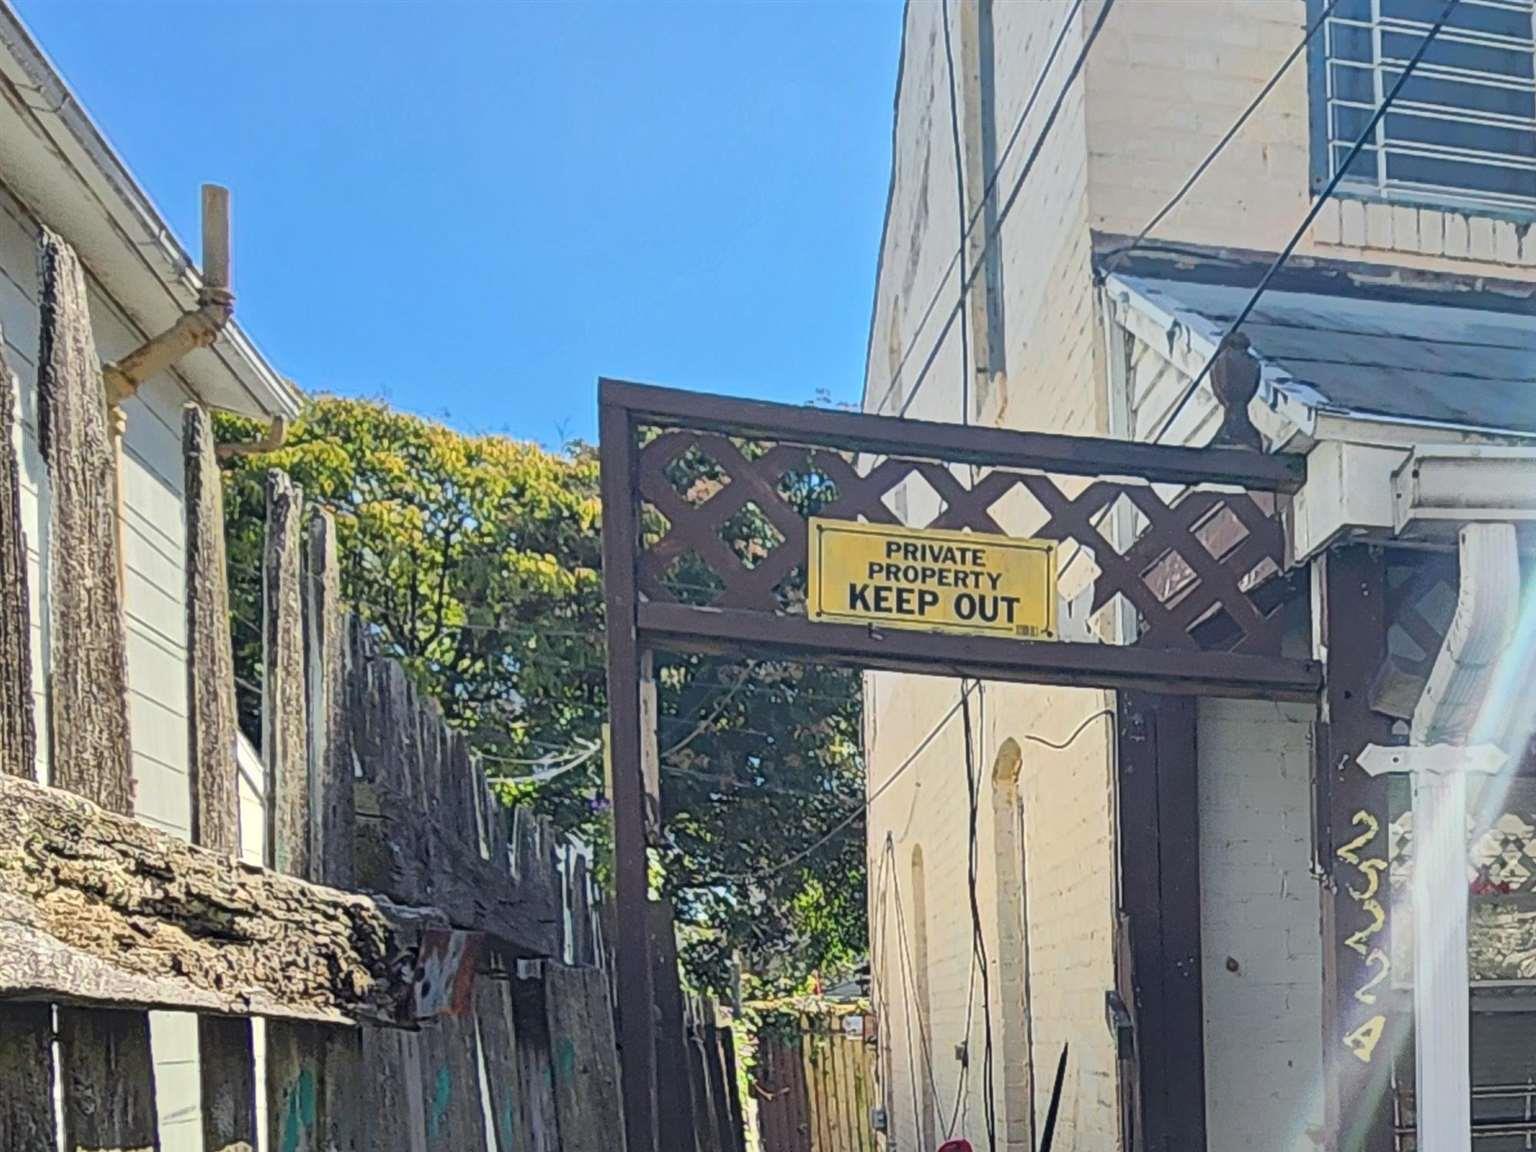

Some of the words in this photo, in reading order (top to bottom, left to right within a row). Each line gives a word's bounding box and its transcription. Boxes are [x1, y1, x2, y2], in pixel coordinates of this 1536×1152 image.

[885, 541, 987, 567] PRIVATE
[867, 562, 1002, 591] PROPERTY
[849, 582, 940, 616] KEEP
[953, 592, 1021, 623] OUT
